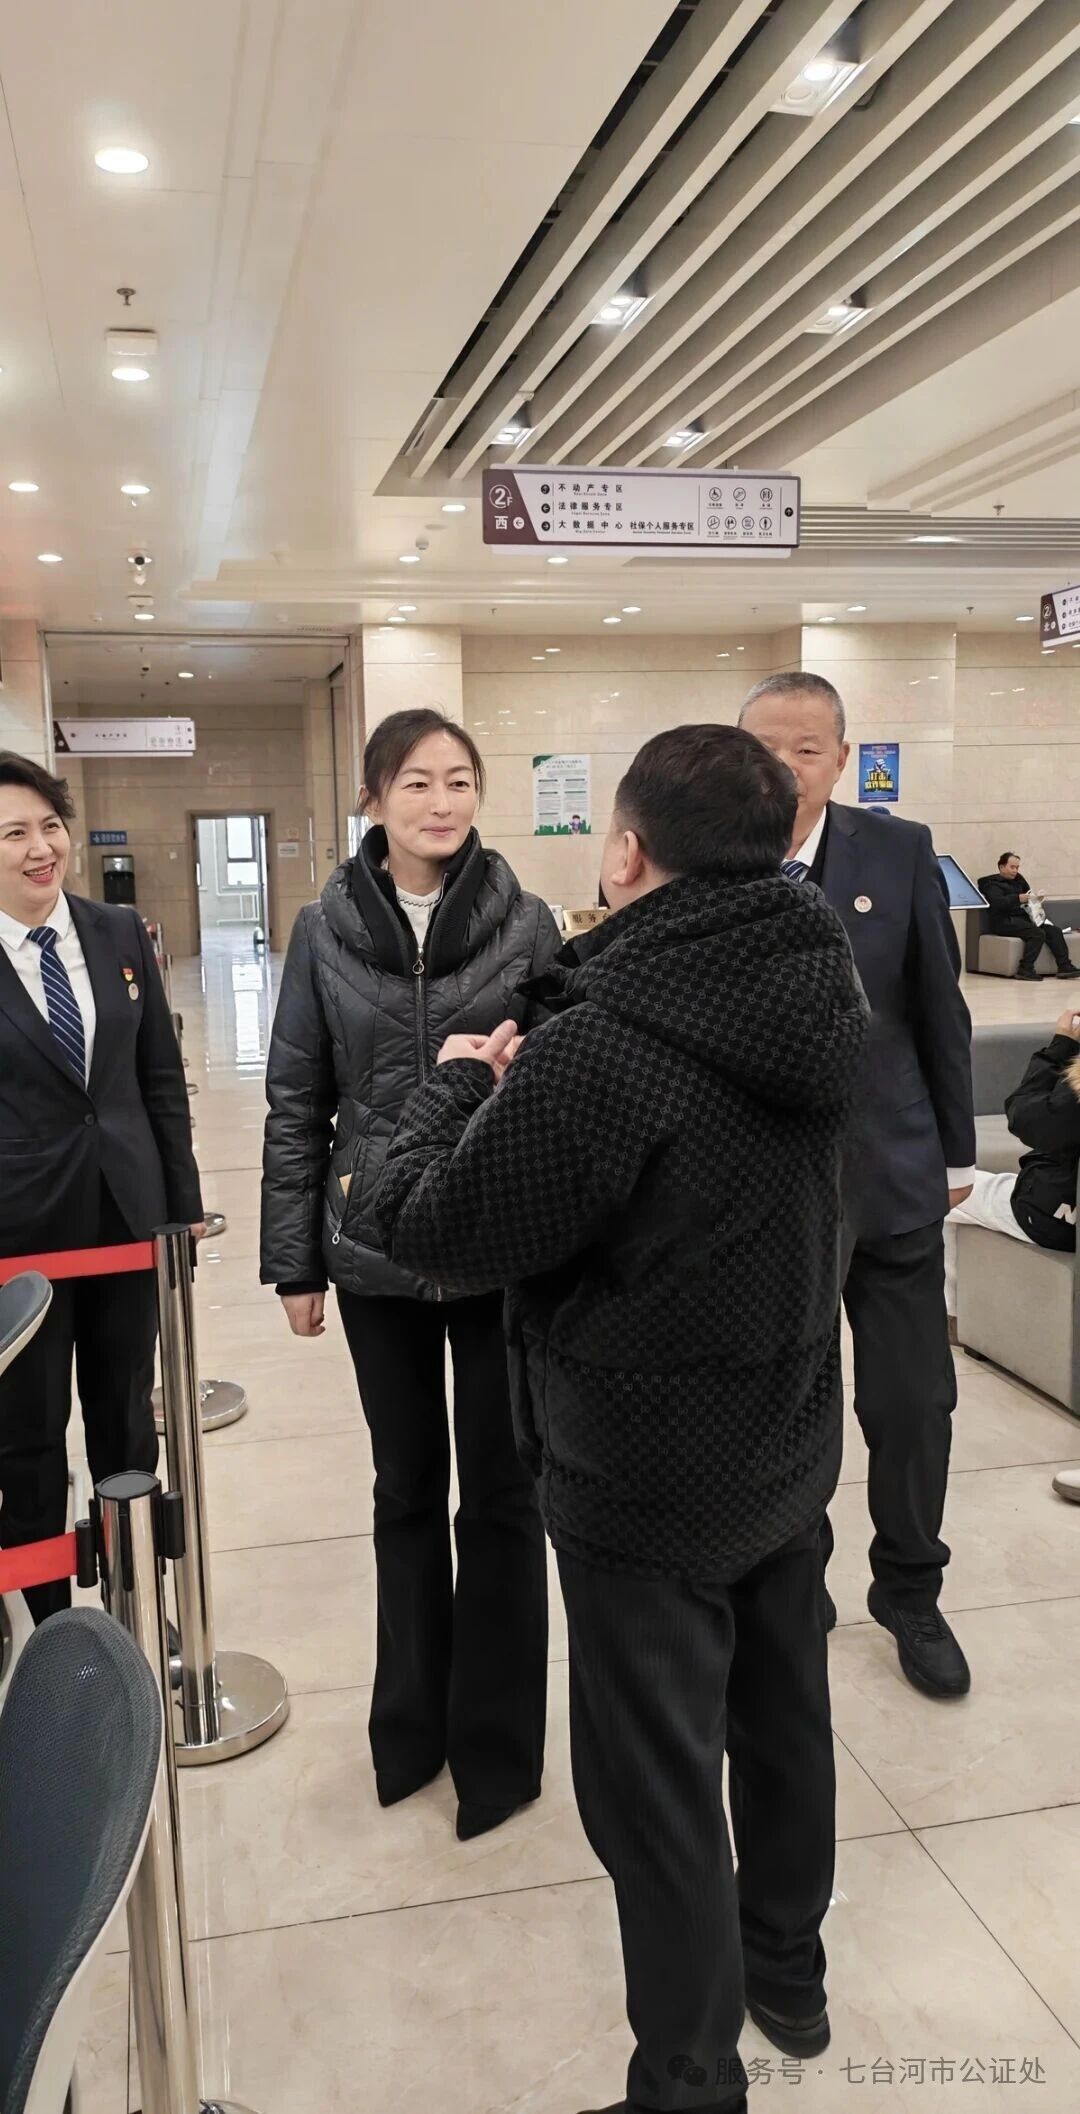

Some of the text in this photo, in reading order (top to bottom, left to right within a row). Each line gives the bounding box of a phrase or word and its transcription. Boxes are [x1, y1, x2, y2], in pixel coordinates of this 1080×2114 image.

[558, 482, 623, 493] 不动产专区
[494, 487, 513, 507] 2F
[558, 501, 623, 512] 法律服务专区
[494, 515, 508, 530] 西
[558, 519, 695, 531] 大数据中心 社保个人服务专区
